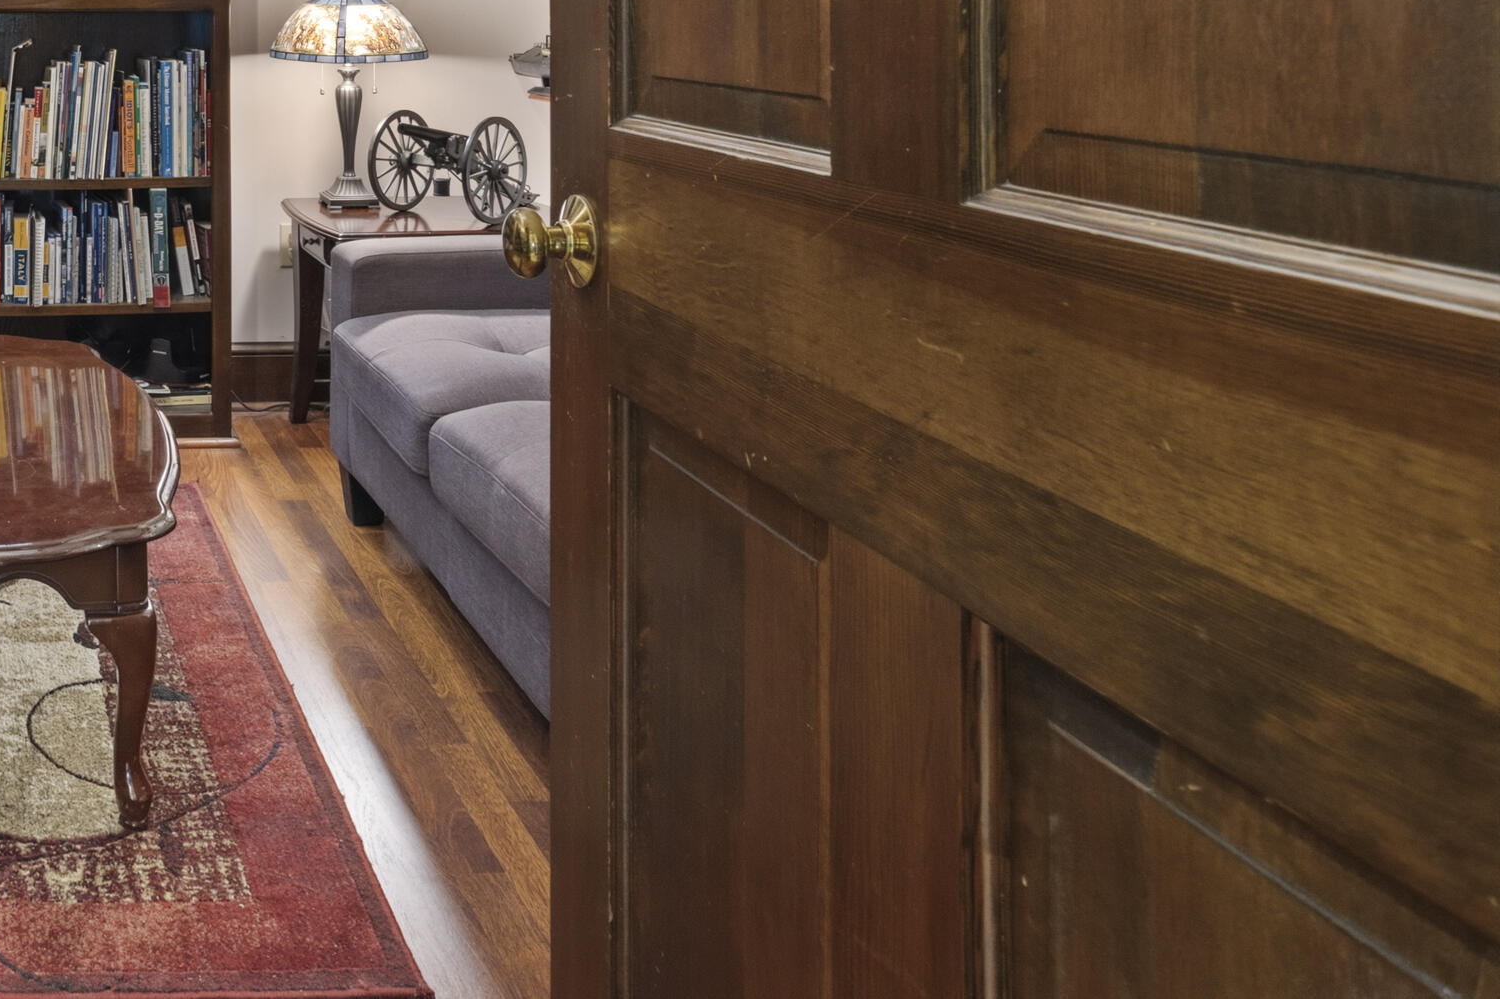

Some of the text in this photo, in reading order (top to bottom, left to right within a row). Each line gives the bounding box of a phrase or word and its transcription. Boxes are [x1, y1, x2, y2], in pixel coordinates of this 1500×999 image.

[126, 99, 135, 169] IDIOT'S Football
[153, 212, 164, 236] D-DAY
[17, 253, 26, 282] ITALY
